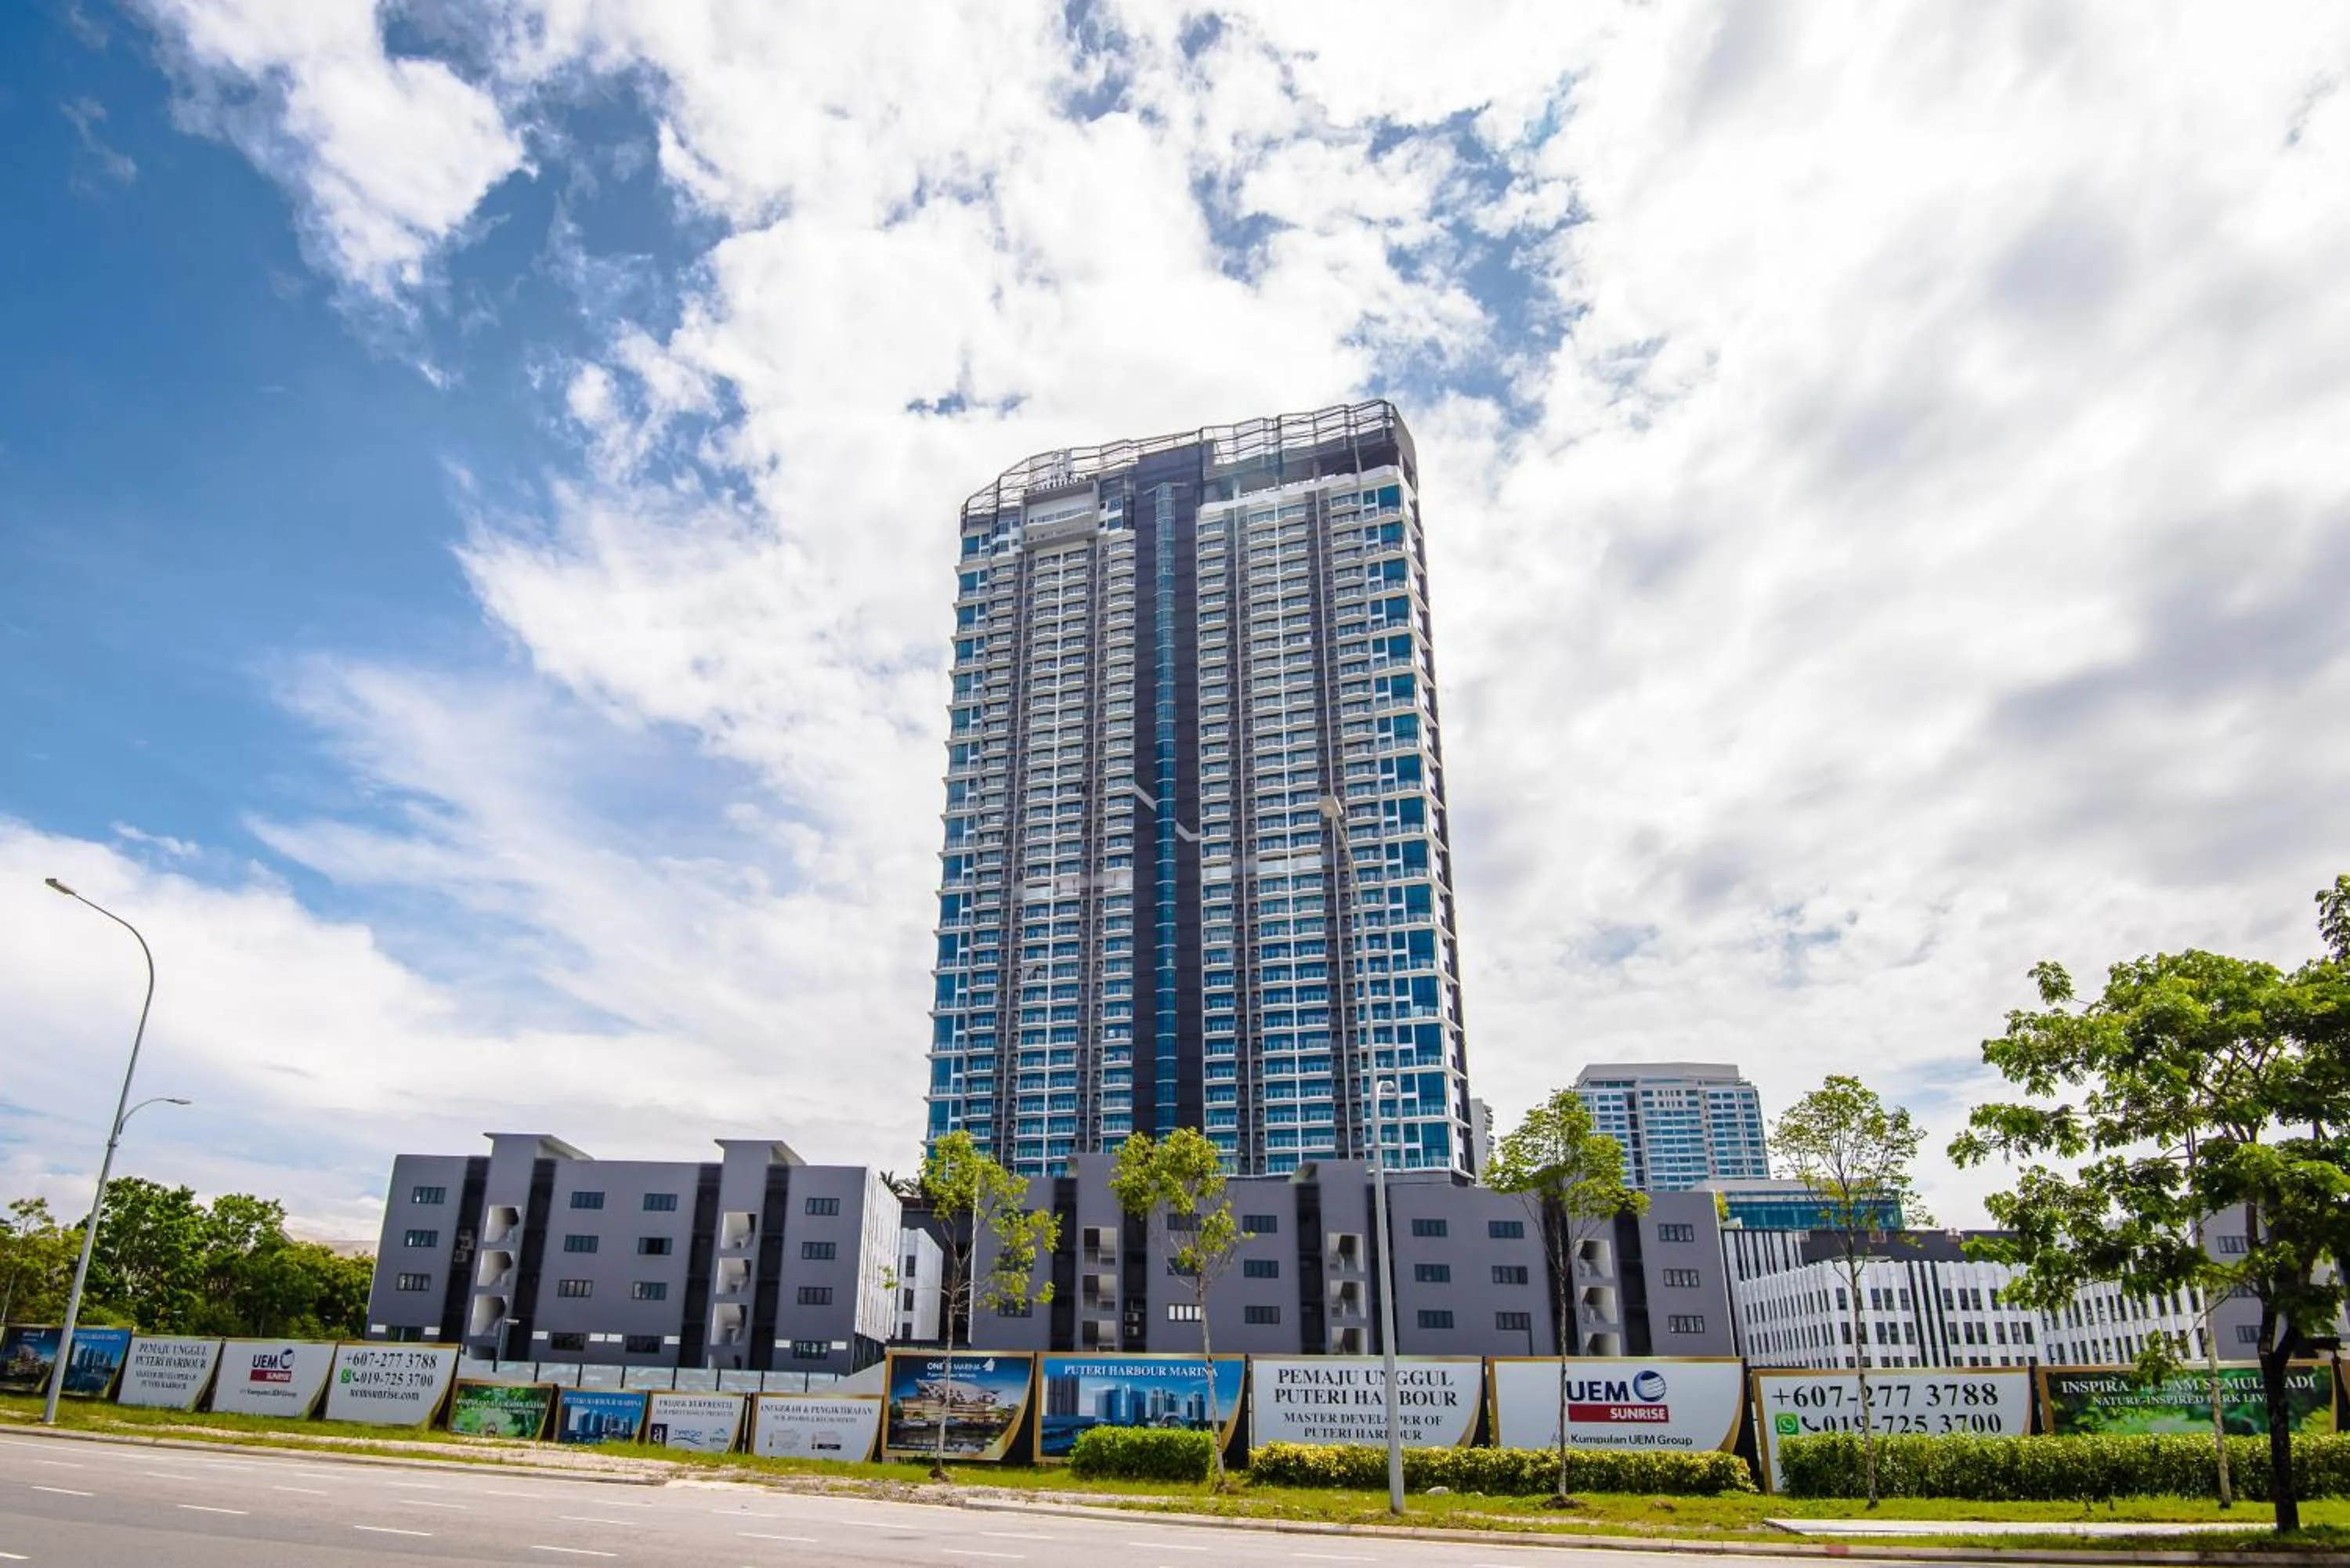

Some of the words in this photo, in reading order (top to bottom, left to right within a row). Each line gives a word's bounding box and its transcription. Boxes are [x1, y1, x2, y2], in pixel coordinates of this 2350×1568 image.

[252, 1354, 277, 1368] UEM
[346, 1353, 403, 1367] +607-277
[406, 1353, 438, 1369] 3788
[1065, 1365, 1106, 1375] PUTERI
[1108, 1365, 1166, 1377] HARBOUR
[1278, 1368, 1358, 1386] PEMAJU
[360, 1371, 404, 1386] 019-725
[407, 1374, 433, 1388] 3700
[1274, 1389, 1347, 1404] PUTERI
[1353, 1390, 1458, 1406] HABOUR
[1566, 1380, 1630, 1402] UEM
[1925, 1382, 1998, 1407] 3788
[1283, 1412, 1337, 1424] MASTER
[1340, 1414, 1422, 1425] DEVELER
[1425, 1415, 1443, 1425] OF
[1610, 1407, 1666, 1420] SUNRISE
[1940, 1413, 2002, 1434] 3700
[1304, 1427, 1351, 1439] PUTERI
[1571, 1434, 1629, 1445] Kumpulan
[1629, 1435, 1655, 1445] UEM
[1658, 1435, 1693, 1447] Group
